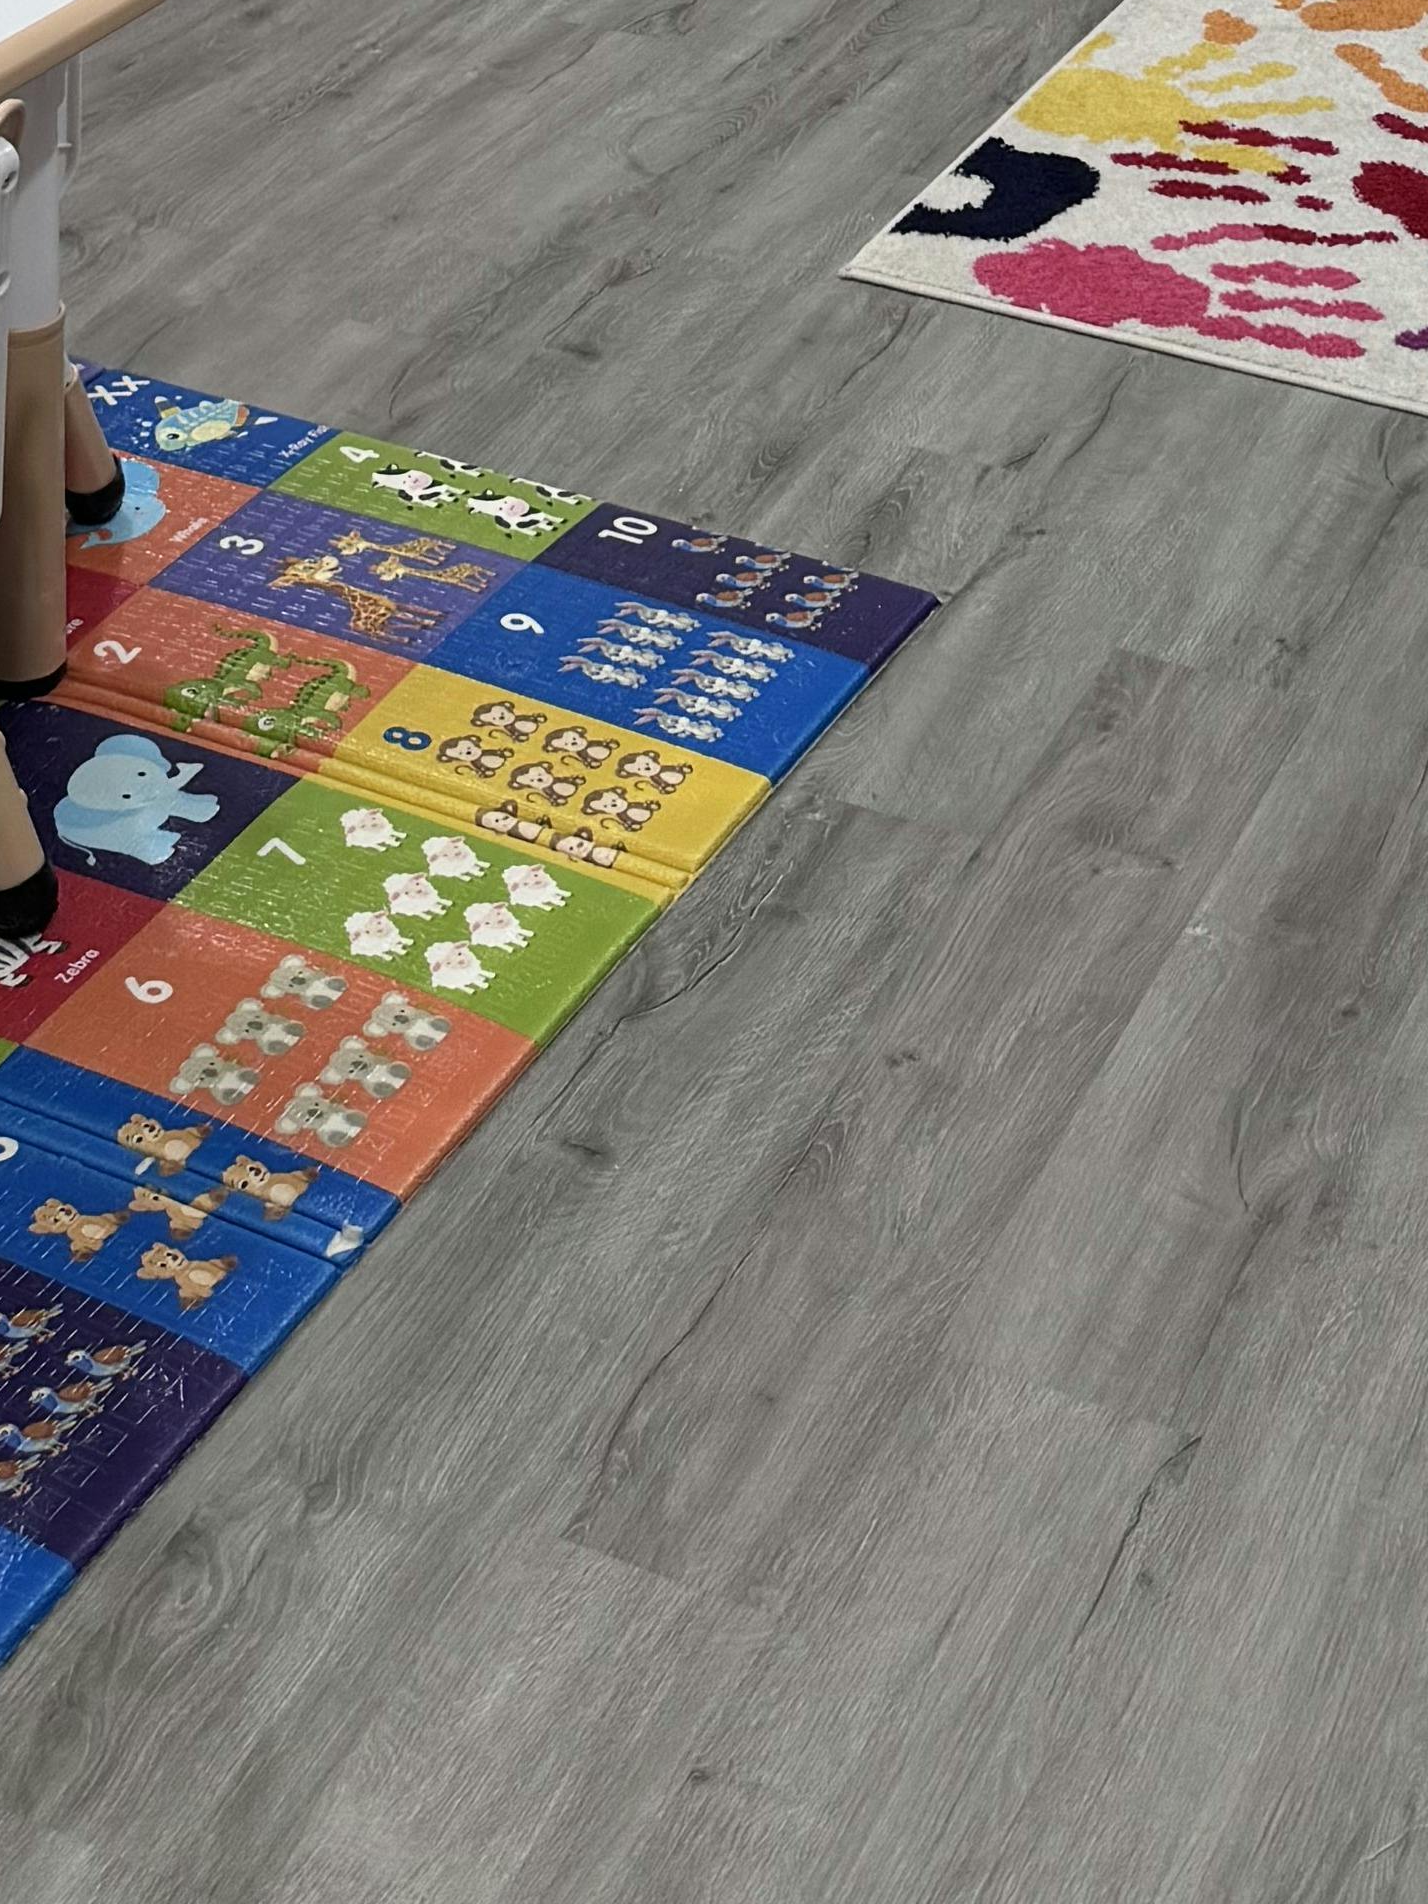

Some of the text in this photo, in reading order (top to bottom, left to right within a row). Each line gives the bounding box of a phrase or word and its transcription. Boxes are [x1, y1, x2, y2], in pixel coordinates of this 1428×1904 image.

[339, 446, 380, 464] 4
[597, 515, 658, 545] 10
[219, 534, 265, 556] 3
[92, 639, 143, 665] 2
[383, 726, 432, 751] 8
[256, 836, 307, 866] 7
[53, 947, 101, 986] Zebra
[124, 975, 175, 1005] 6
